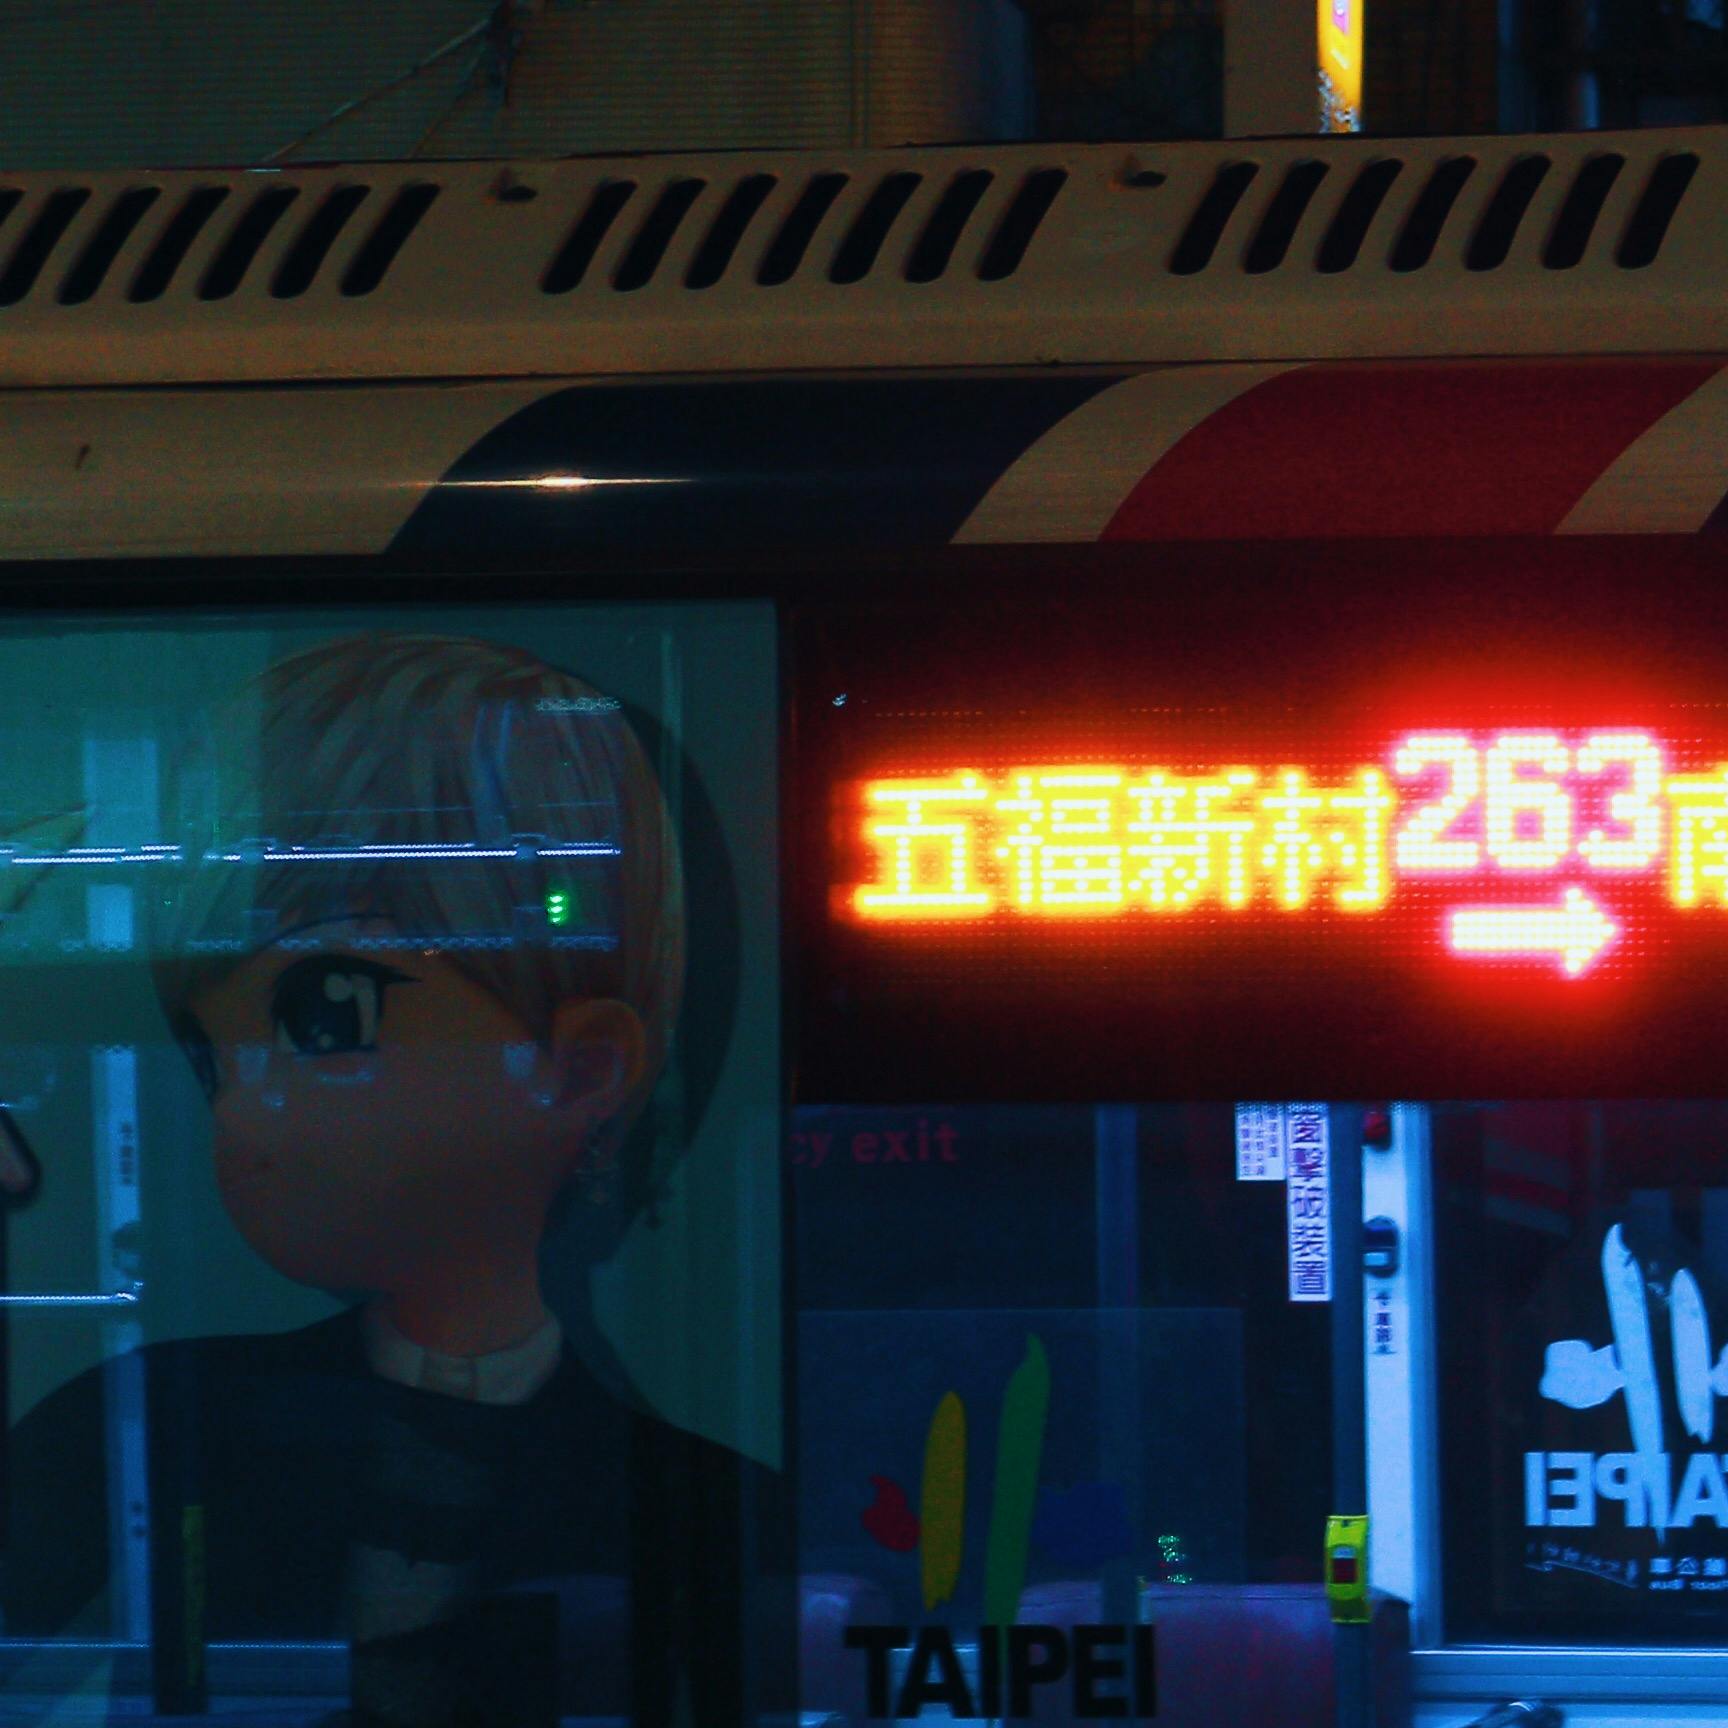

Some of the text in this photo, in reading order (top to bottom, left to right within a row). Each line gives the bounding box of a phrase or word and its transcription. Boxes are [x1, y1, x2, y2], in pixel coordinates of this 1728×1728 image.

[853, 768, 1394, 916] 五福新村
[1392, 732, 1668, 870] 263
[852, 1116, 961, 1165] exit
[844, 1622, 1158, 1719] TAIPEI
